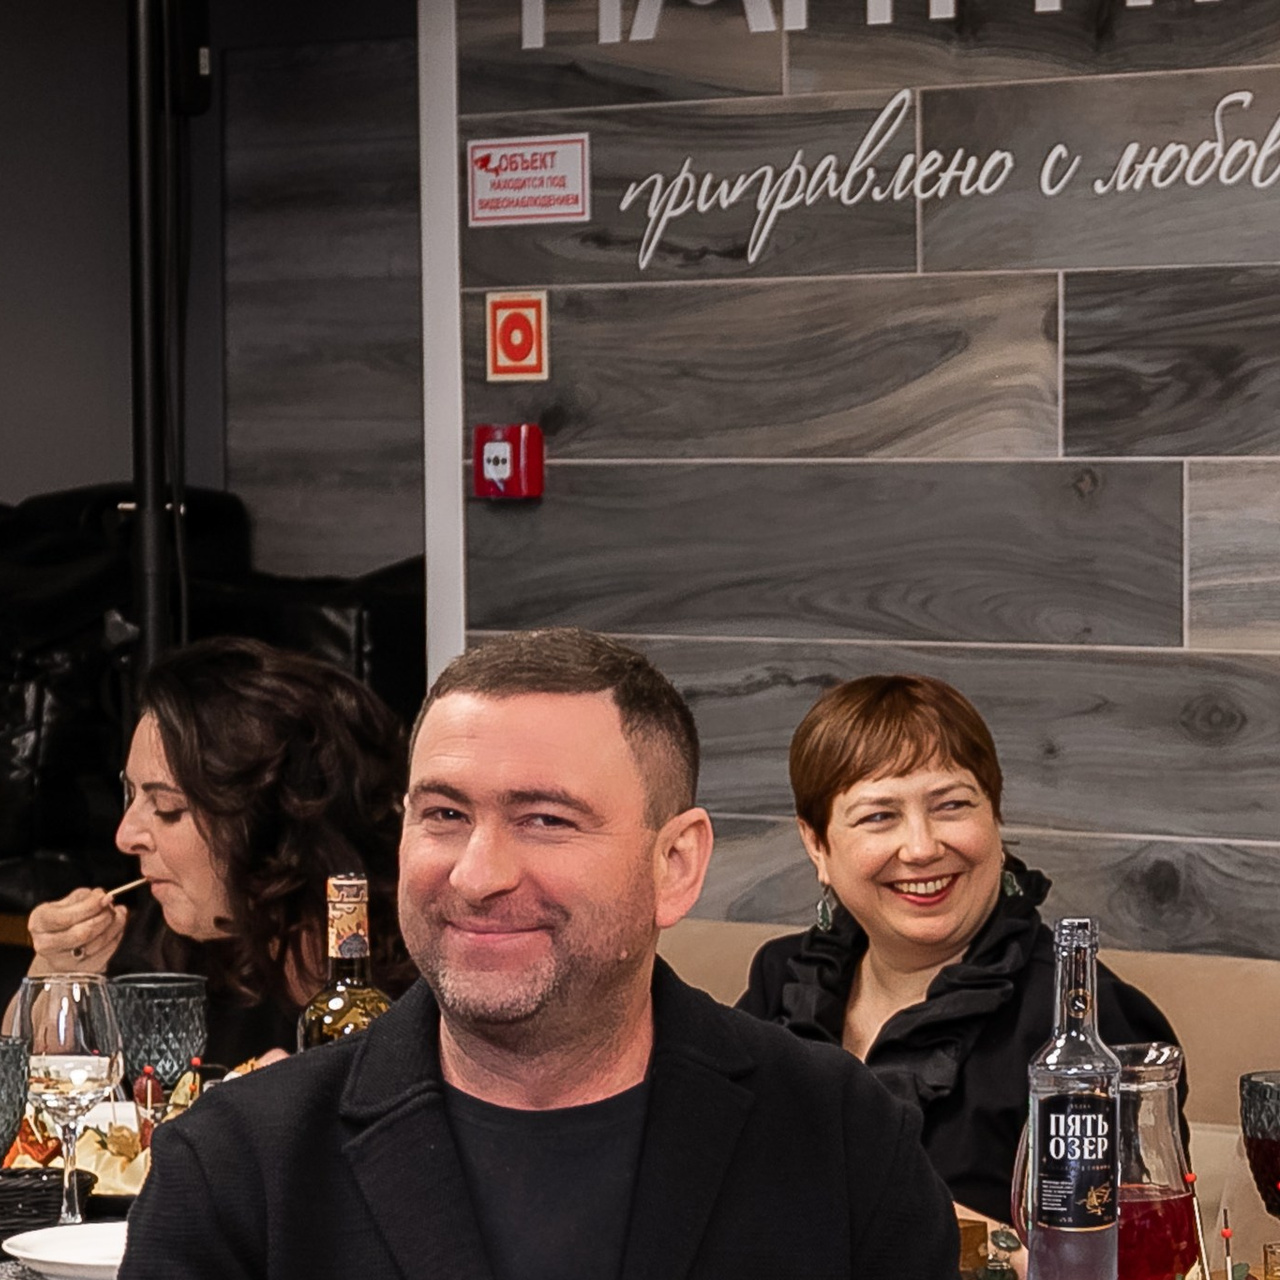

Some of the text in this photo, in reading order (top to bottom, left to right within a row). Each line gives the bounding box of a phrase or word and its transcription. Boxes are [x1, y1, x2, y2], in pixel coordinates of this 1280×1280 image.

[499, 151, 557, 172] ОБЪЕКТ
[620, 88, 1014, 271] приправлено
[1041, 142, 1081, 196] с
[1049, 1113, 1109, 1137] ПЯТЬ
[1049, 1137, 1109, 1160] ОЗЕР
